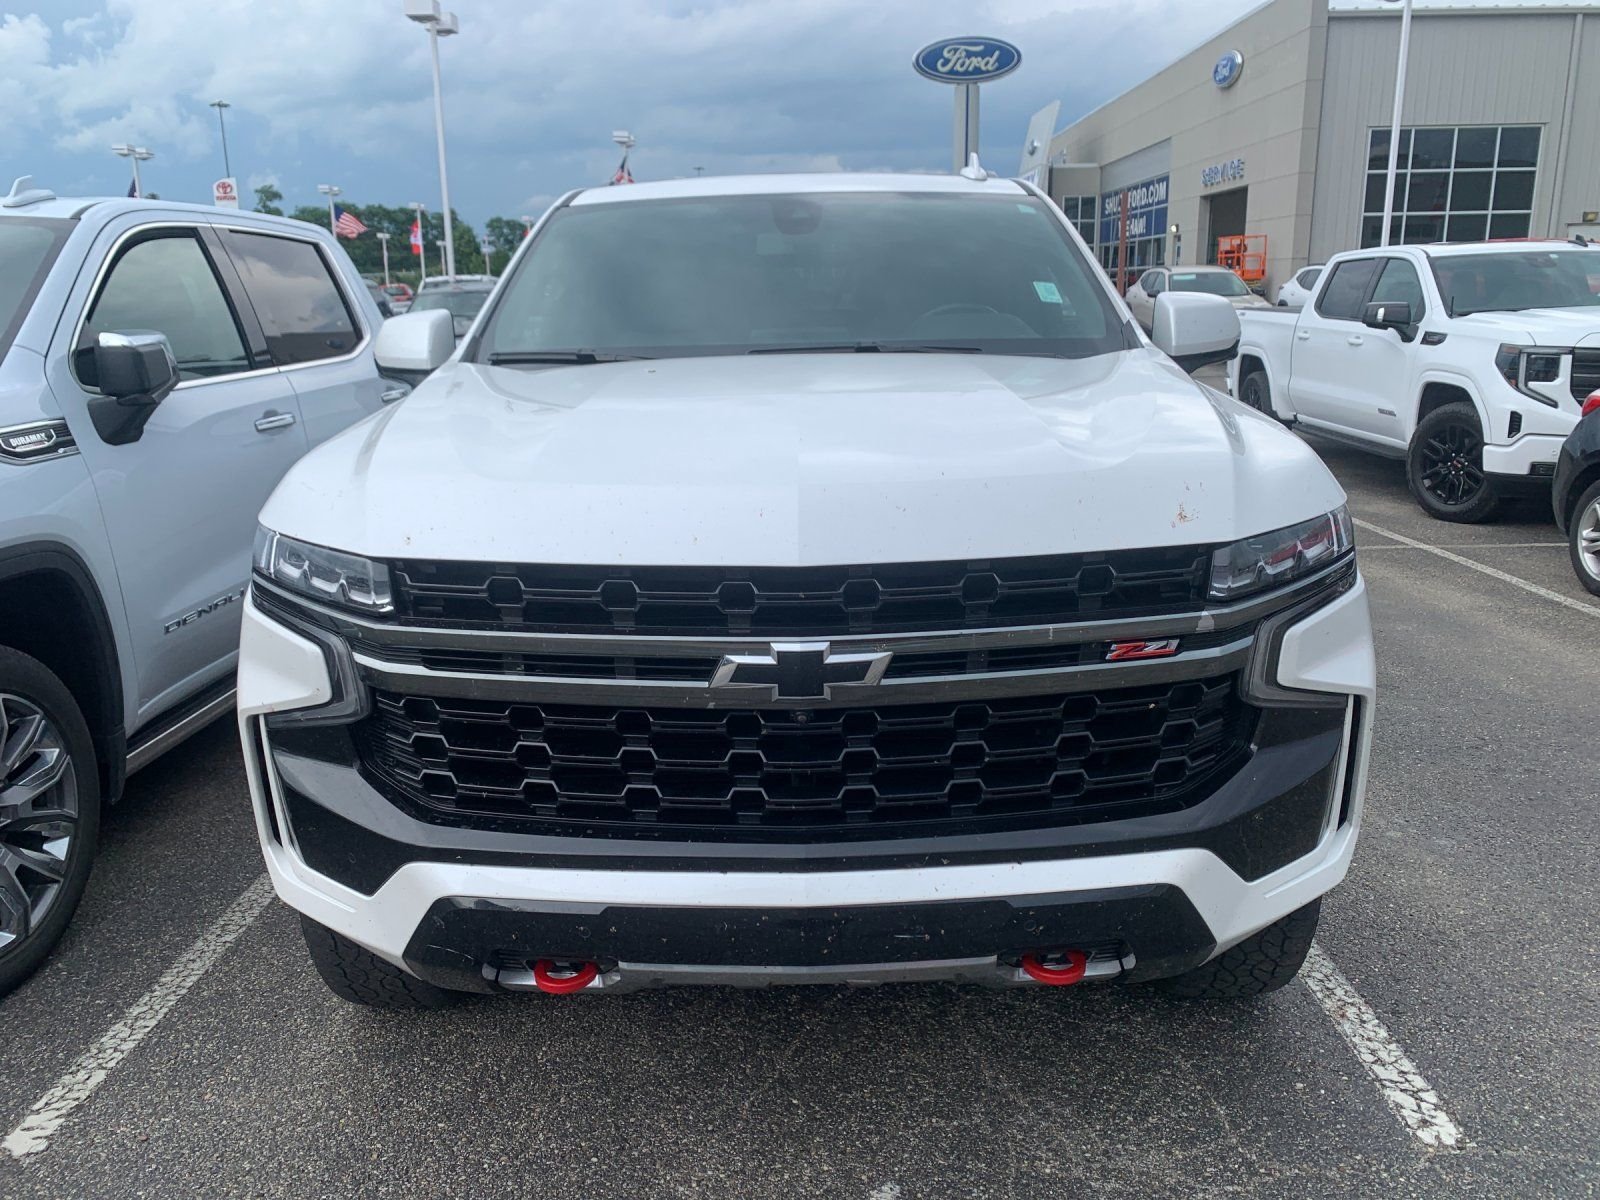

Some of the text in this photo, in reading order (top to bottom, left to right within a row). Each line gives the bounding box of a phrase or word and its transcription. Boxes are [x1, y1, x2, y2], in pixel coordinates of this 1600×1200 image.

[936, 45, 1000, 73] Ford
[9, 432, 48, 447] DURAMAX
[163, 587, 244, 635] DENALI
[1105, 639, 1180, 661] Z71
